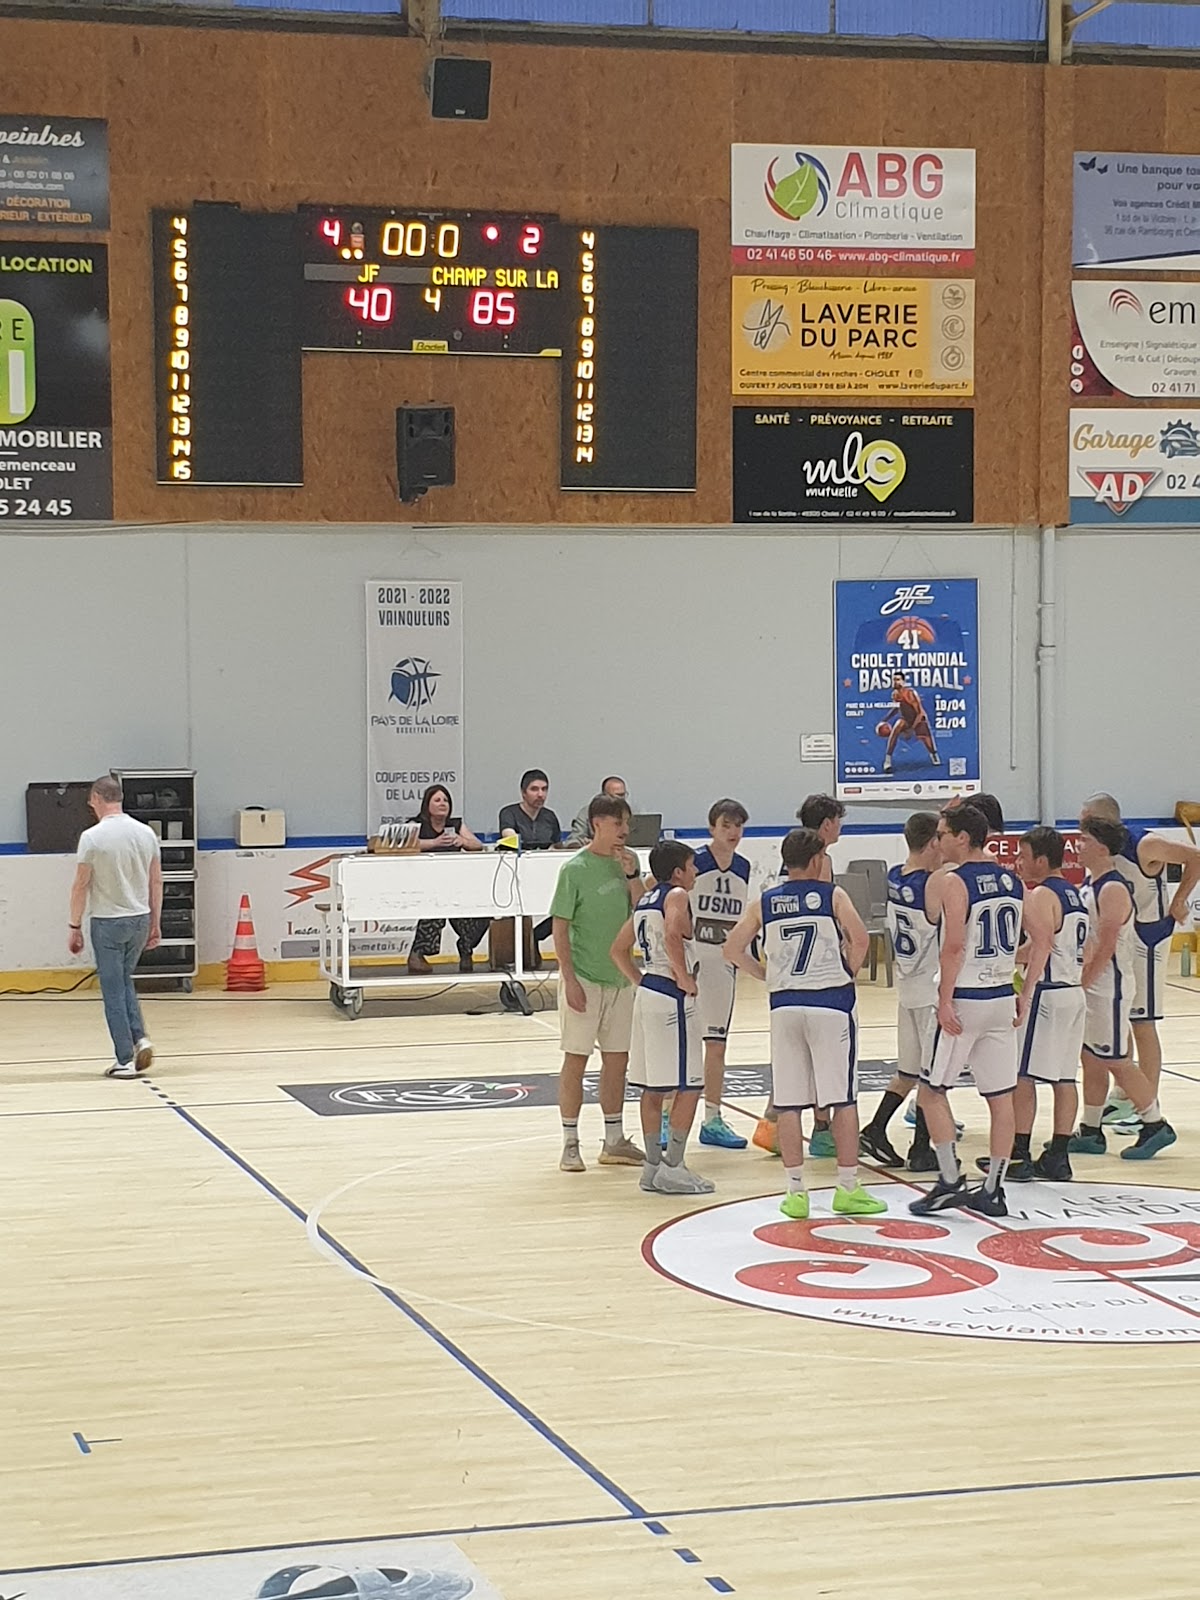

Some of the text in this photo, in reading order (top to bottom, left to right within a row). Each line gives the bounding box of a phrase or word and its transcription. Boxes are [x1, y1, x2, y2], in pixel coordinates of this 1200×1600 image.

[836, 152, 944, 199] ABG
[1117, 163, 1182, 176] Une banque
[1157, 182, 1183, 191] pour
[7, 195, 70, 208] DÉCORATION
[37, 210, 92, 223] EXTÉRIEUR
[835, 201, 944, 222] Climatique
[173, 217, 188, 235] 4
[323, 220, 341, 246] 4
[745, 229, 963, 241] Chauffage Climatisation Plomberie Ventilation
[173, 238, 187, 258] 5
[522, 227, 541, 254] 2
[582, 231, 595, 250] 4
[1, 256, 93, 273] LOCATION
[582, 252, 594, 272] 5
[747, 248, 762, 260] 02
[766, 249, 778, 260] 41
[799, 249, 814, 260] 50
[838, 251, 960, 264] www.abg-climatique.fr
[174, 261, 188, 281] 6
[357, 264, 380, 283] JF
[432, 267, 558, 289] CHAMP SUR LA
[176, 283, 188, 302] 7
[581, 274, 594, 293] 6
[349, 287, 392, 322] 40
[424, 287, 441, 312] 4
[473, 291, 515, 325] 85
[583, 296, 594, 314] 7
[175, 305, 189, 325] 8
[801, 303, 918, 324] LAVERIE
[581, 317, 594, 337] 8
[175, 328, 189, 347] 9
[801, 328, 918, 348] DU PARC
[1100, 340, 1197, 350] Enseigne Signalétique
[581, 338, 594, 358] 9
[171, 350, 189, 370] 10
[1146, 355, 1161, 363] Cut
[577, 360, 593, 379] 10
[171, 373, 190, 390] 11
[577, 383, 593, 399] 11
[1152, 382, 1196, 393] 02 41 71
[172, 394, 190, 413] 12
[577, 403, 593, 421] 12
[172, 416, 190, 436] 13
[755, 413, 953, 425] SANTÉ PRÉVOYANCE RETRAITE
[577, 424, 593, 443] 13
[1073, 423, 1157, 458] Garage
[172, 439, 191, 456] 14
[577, 446, 593, 463] 14
[173, 460, 191, 480] 15
[1094, 473, 1145, 503] AD
[1167, 474, 1186, 489] 02
[806, 486, 858, 498] mutuelle
[15, 499, 41, 515] 24
[45, 500, 72, 516] 45
[378, 587, 450, 604] 2021 2022
[379, 610, 450, 626] VAINQUEURS
[851, 652, 967, 668] CHOLET MONDIAL
[859, 667, 964, 693] BASETBALL
[399, 715, 412, 726] DE
[415, 715, 430, 727] LA
[936, 717, 966, 729] 21/04
[376, 771, 456, 783] COUPE DES PAYS
[386, 788, 399, 800] DE
[402, 789, 415, 800] LA
[716, 877, 730, 894] 11
[698, 895, 742, 915] USND
[894, 911, 918, 958] 6
[974, 903, 1019, 958] 10
[780, 922, 817, 976] 7
[1062, 1194, 1145, 1206] LES
[1105, 1297, 1148, 1306] DU
